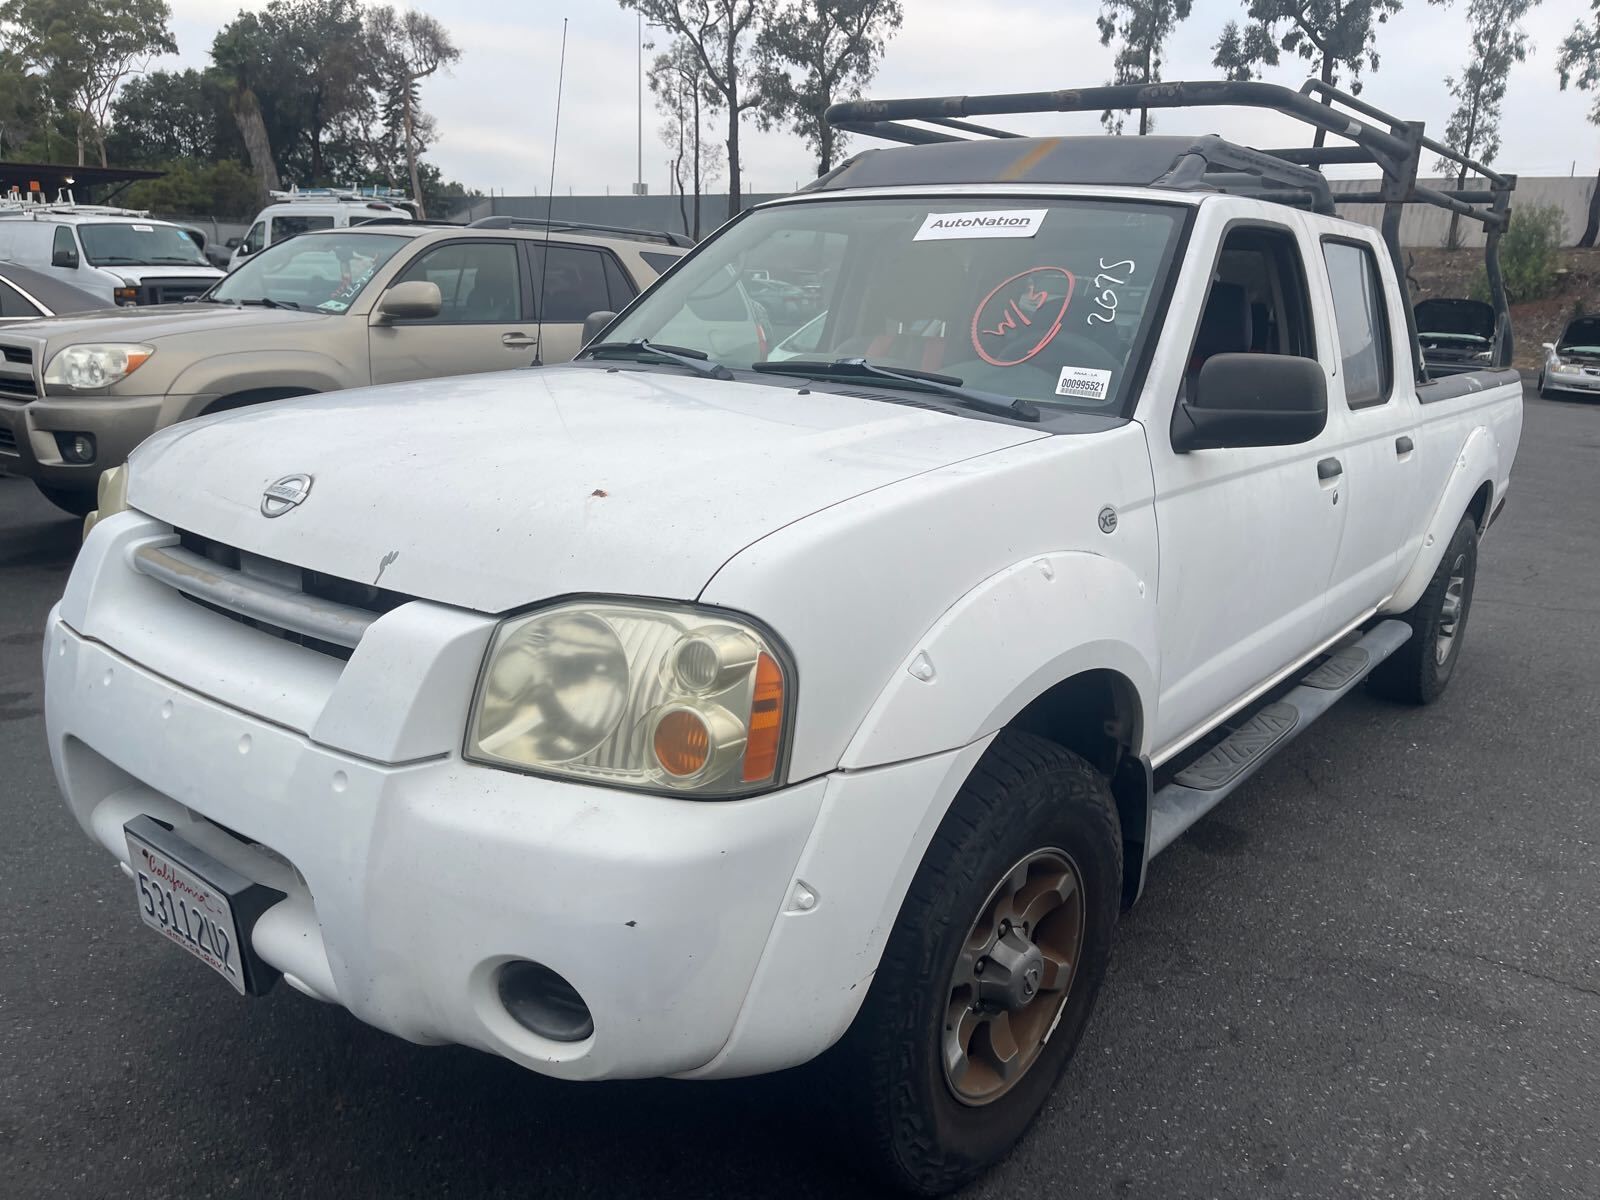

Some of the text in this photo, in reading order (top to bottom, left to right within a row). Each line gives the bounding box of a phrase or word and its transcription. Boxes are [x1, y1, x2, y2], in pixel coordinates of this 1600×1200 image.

[930, 216, 1031, 229] AutoNation
[1087, 257, 1135, 325] 2675
[1061, 378, 1104, 392] 000995521
[1101, 513, 1116, 529] XE
[149, 854, 207, 903] California
